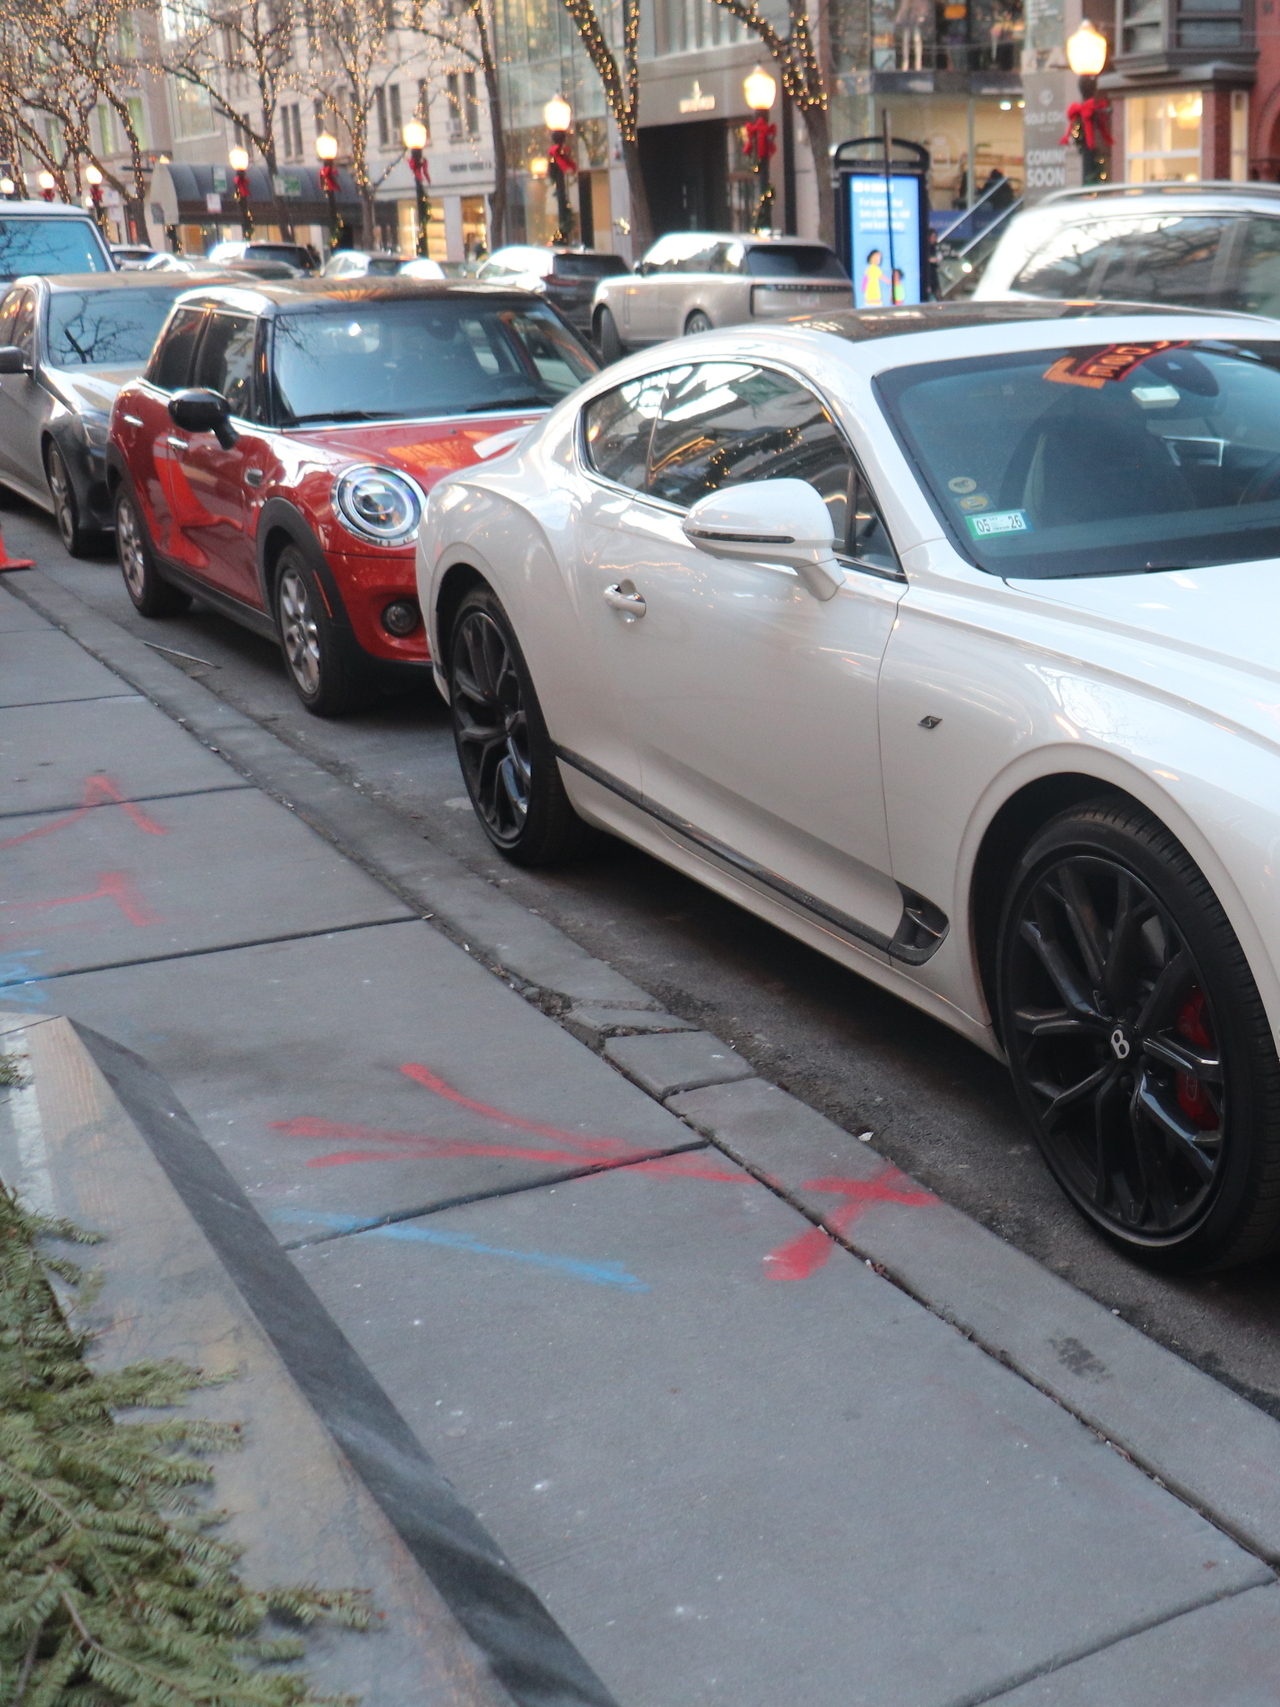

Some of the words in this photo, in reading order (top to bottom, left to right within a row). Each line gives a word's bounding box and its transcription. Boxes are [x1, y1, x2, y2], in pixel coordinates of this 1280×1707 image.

[1027, 167, 1066, 188] SOON
[976, 518, 991, 532] 05
[1008, 514, 1023, 529] 26
[1110, 1029, 1130, 1059] B
